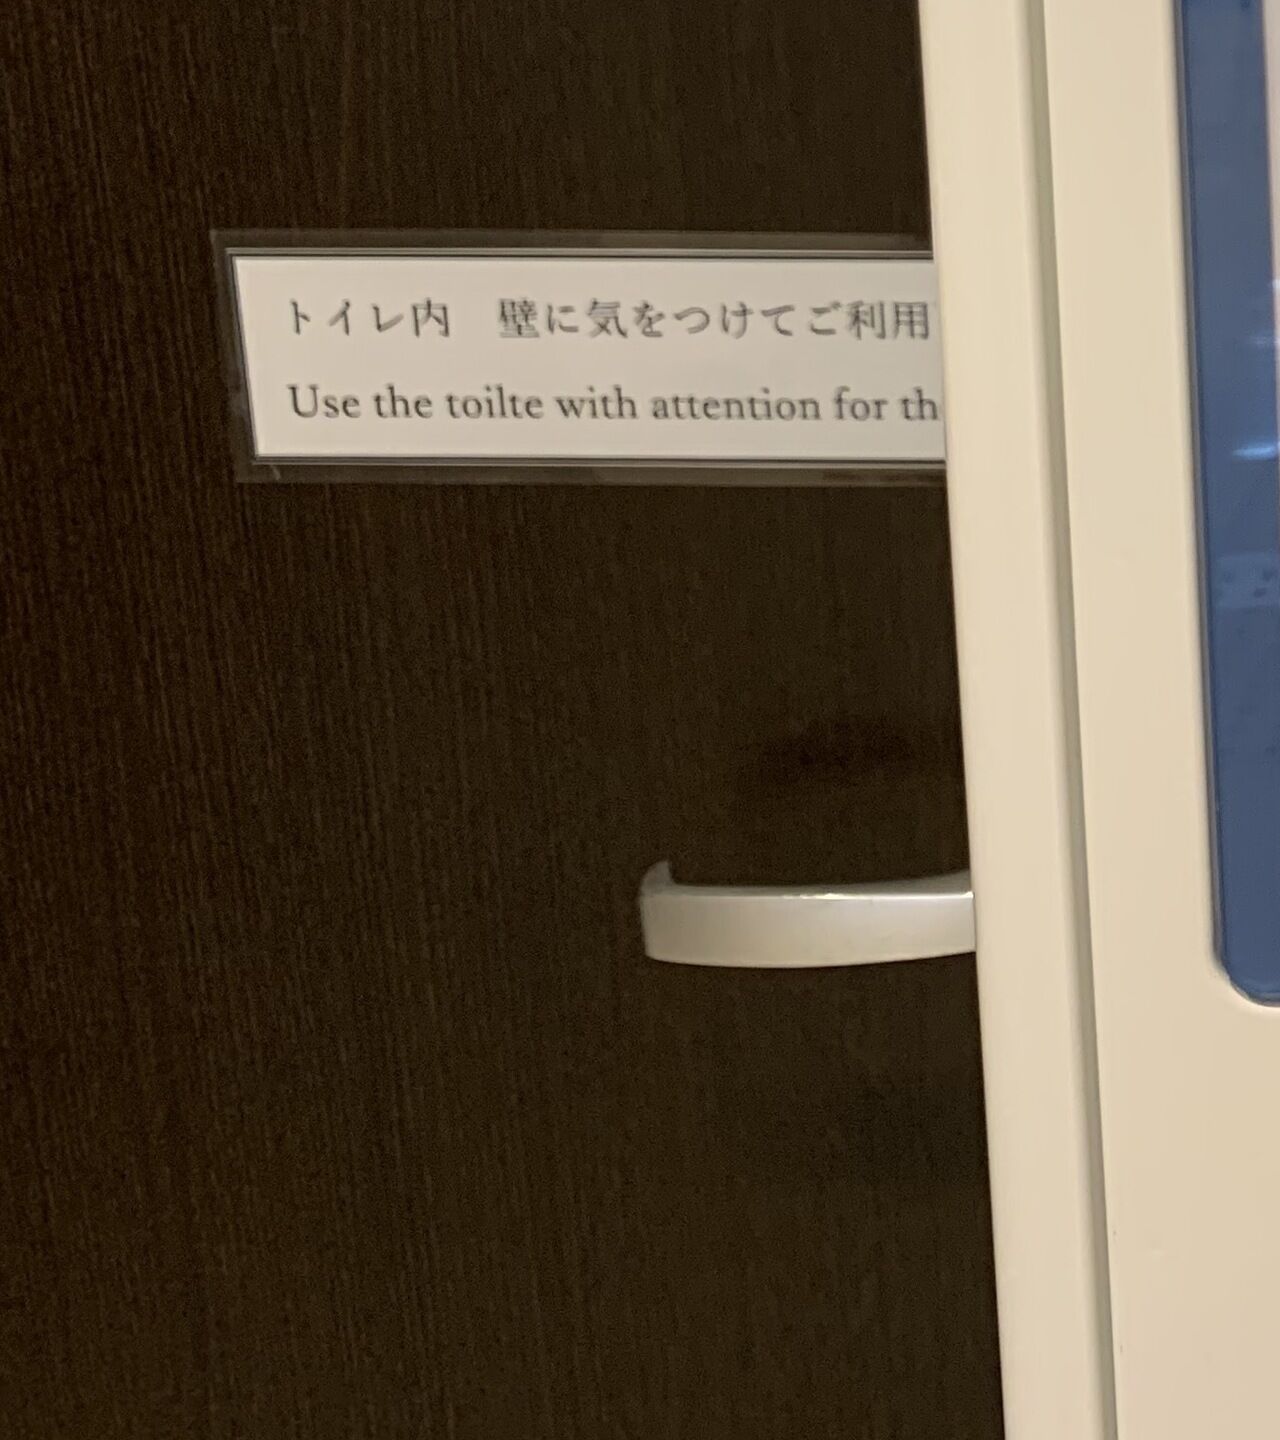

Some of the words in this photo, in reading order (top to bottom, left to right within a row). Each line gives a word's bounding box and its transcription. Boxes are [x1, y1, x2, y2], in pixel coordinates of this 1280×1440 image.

[290, 297, 449, 337] トイレ内
[287, 383, 361, 419] Use
[372, 383, 433, 419] the
[445, 383, 544, 420] toilte
[554, 384, 638, 420] with
[651, 387, 822, 421] attention
[832, 385, 889, 421] for
